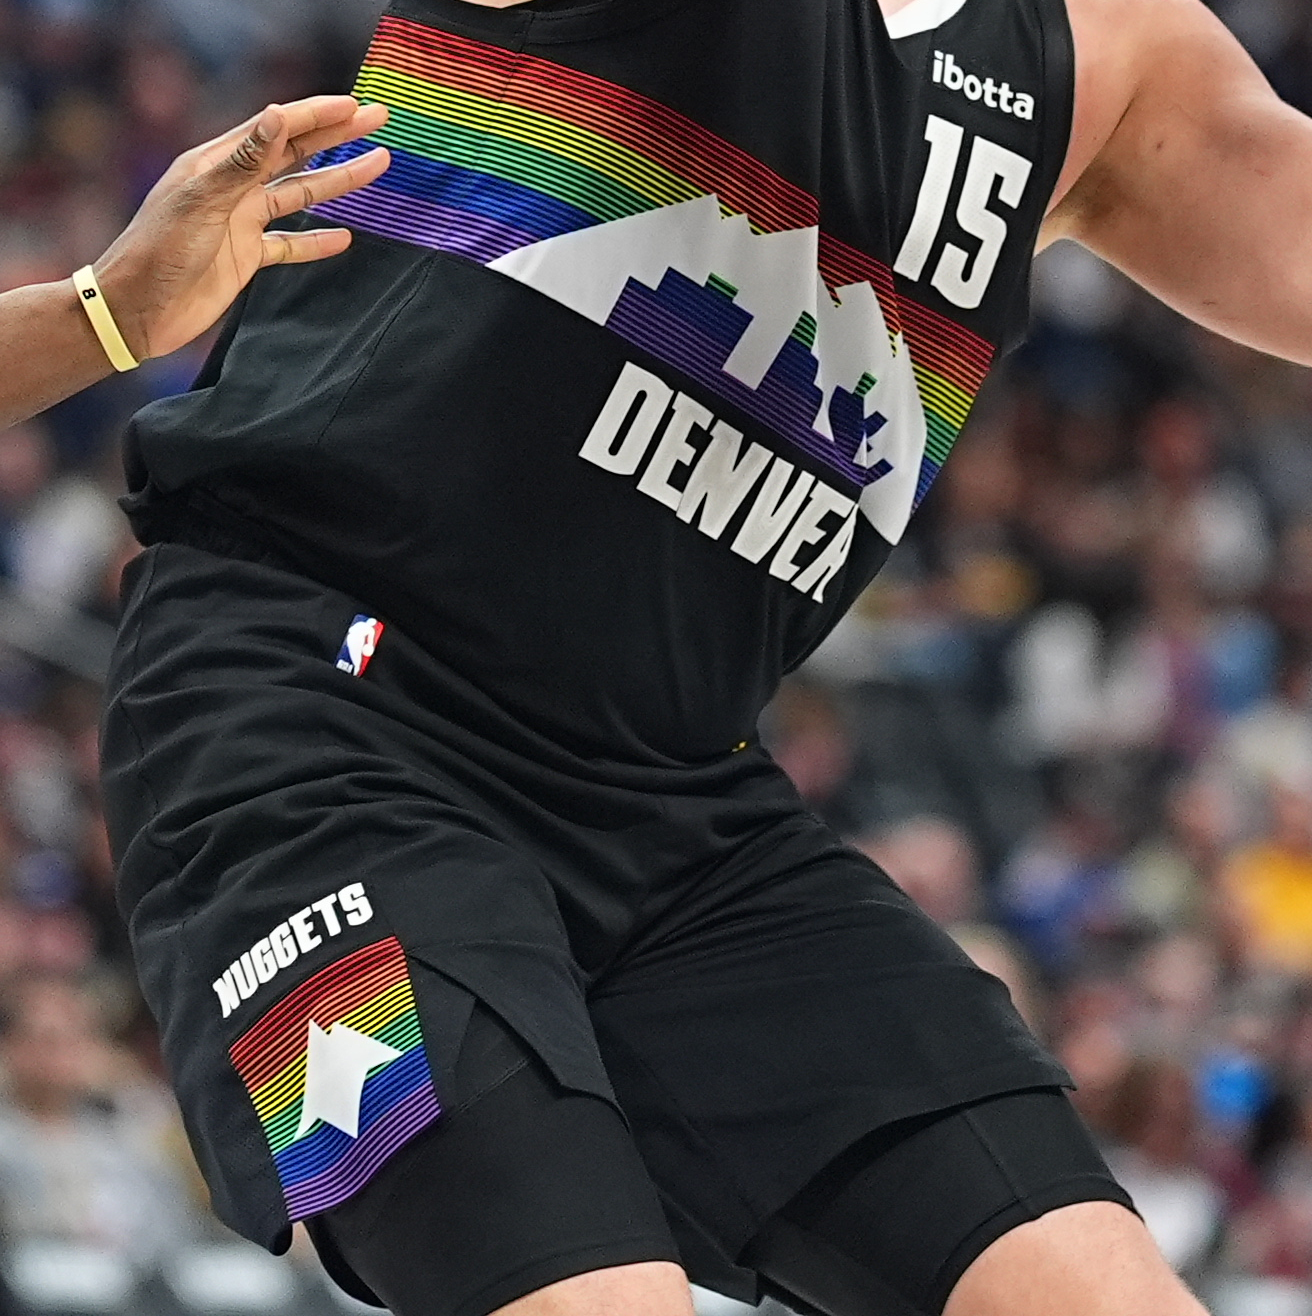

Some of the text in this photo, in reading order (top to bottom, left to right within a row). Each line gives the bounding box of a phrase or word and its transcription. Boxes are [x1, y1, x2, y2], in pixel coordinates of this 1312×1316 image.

[932, 49, 1036, 121] ibotta
[892, 113, 1034, 310] 15
[211, 881, 374, 1019] NUGGETS
